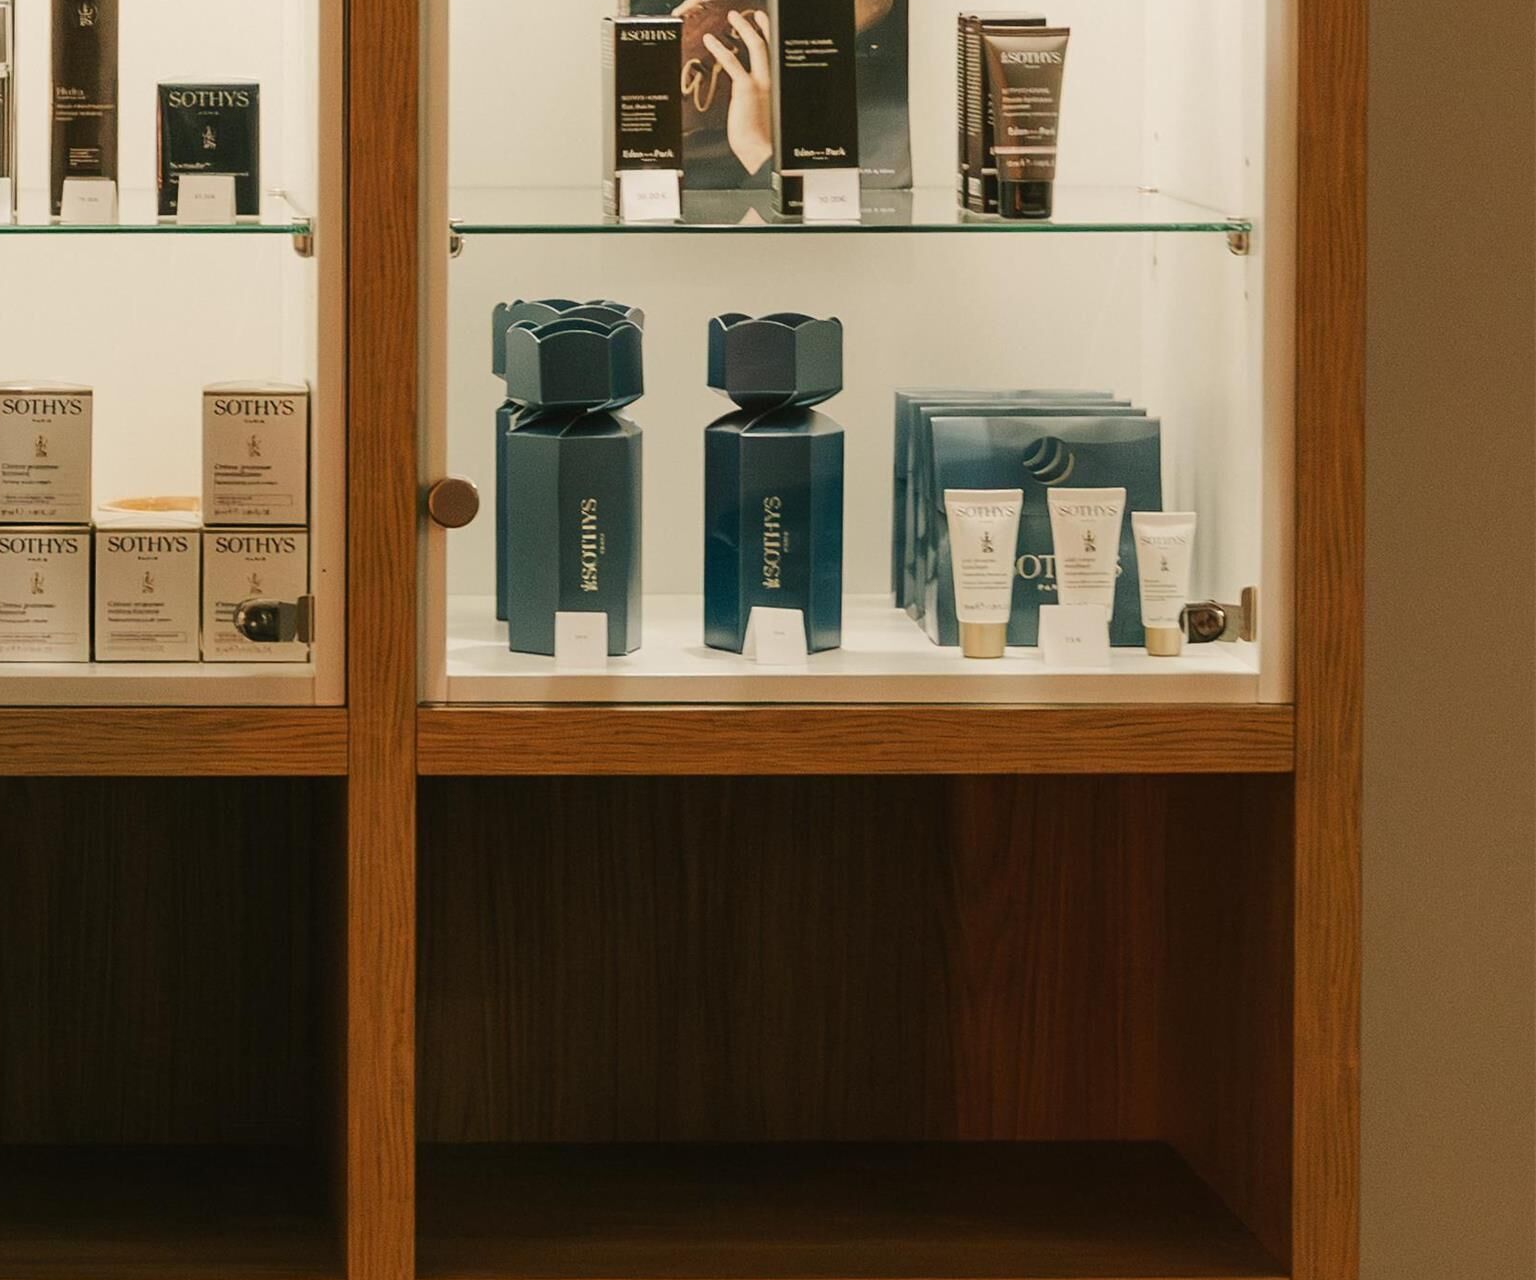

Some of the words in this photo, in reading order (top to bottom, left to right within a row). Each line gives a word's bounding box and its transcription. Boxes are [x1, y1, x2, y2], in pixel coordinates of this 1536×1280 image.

[627, 30, 677, 42] SOTHYS
[1008, 52, 1061, 64] SOTHYS
[168, 91, 250, 108] SOTHYS
[2, 399, 82, 415] SOTHYS
[214, 399, 295, 416] SOTHYS
[956, 504, 1015, 518] SOTHYS
[1058, 504, 1118, 518] SOTHYS
[107, 536, 188, 553] SOTHYS
[215, 536, 296, 554] SOTHYS
[580, 498, 598, 580] SOTHYS
[763, 496, 782, 577] SOTHYS
